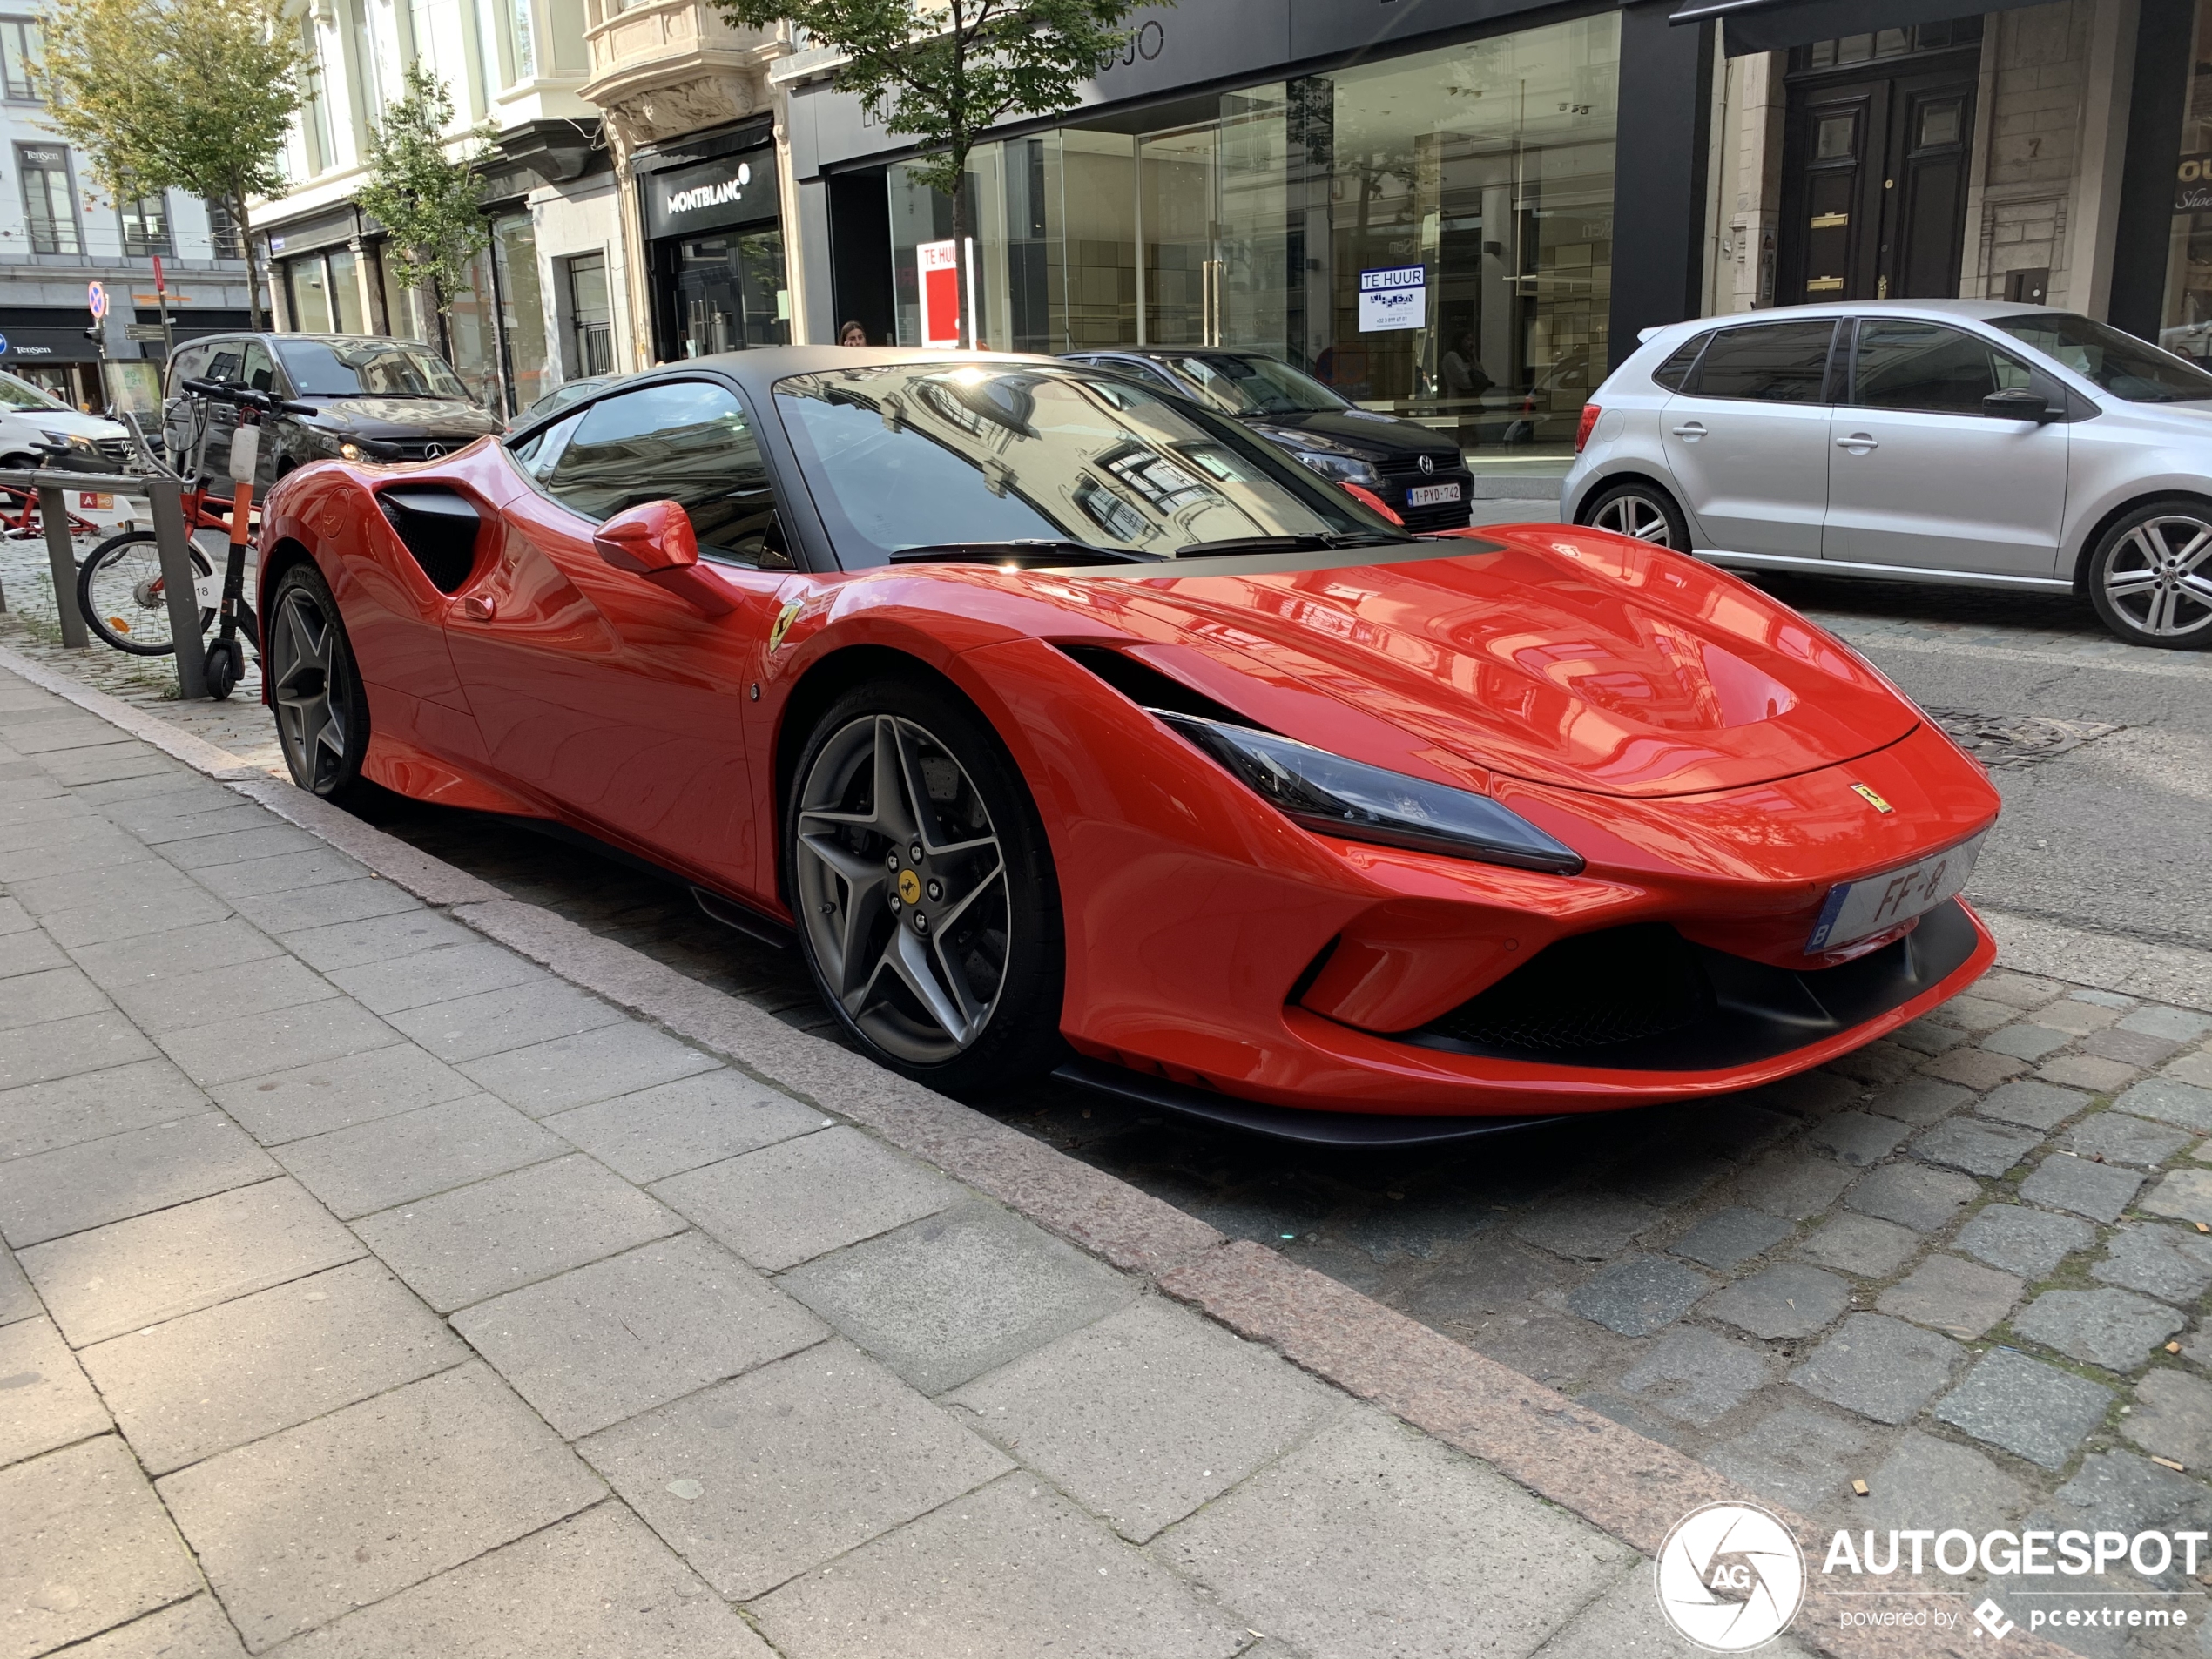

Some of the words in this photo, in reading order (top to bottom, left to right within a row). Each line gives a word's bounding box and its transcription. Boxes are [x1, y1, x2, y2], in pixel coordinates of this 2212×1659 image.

[24, 150, 59, 161] TenSen
[2029, 138, 2040, 158] 7
[667, 179, 741, 214] MONTBLANC
[924, 249, 936, 265] TE
[1364, 274, 1379, 287] TE
[1384, 270, 1421, 286] HUUR
[1874, 860, 1946, 922] FF-8
[1812, 924, 1829, 945] B
